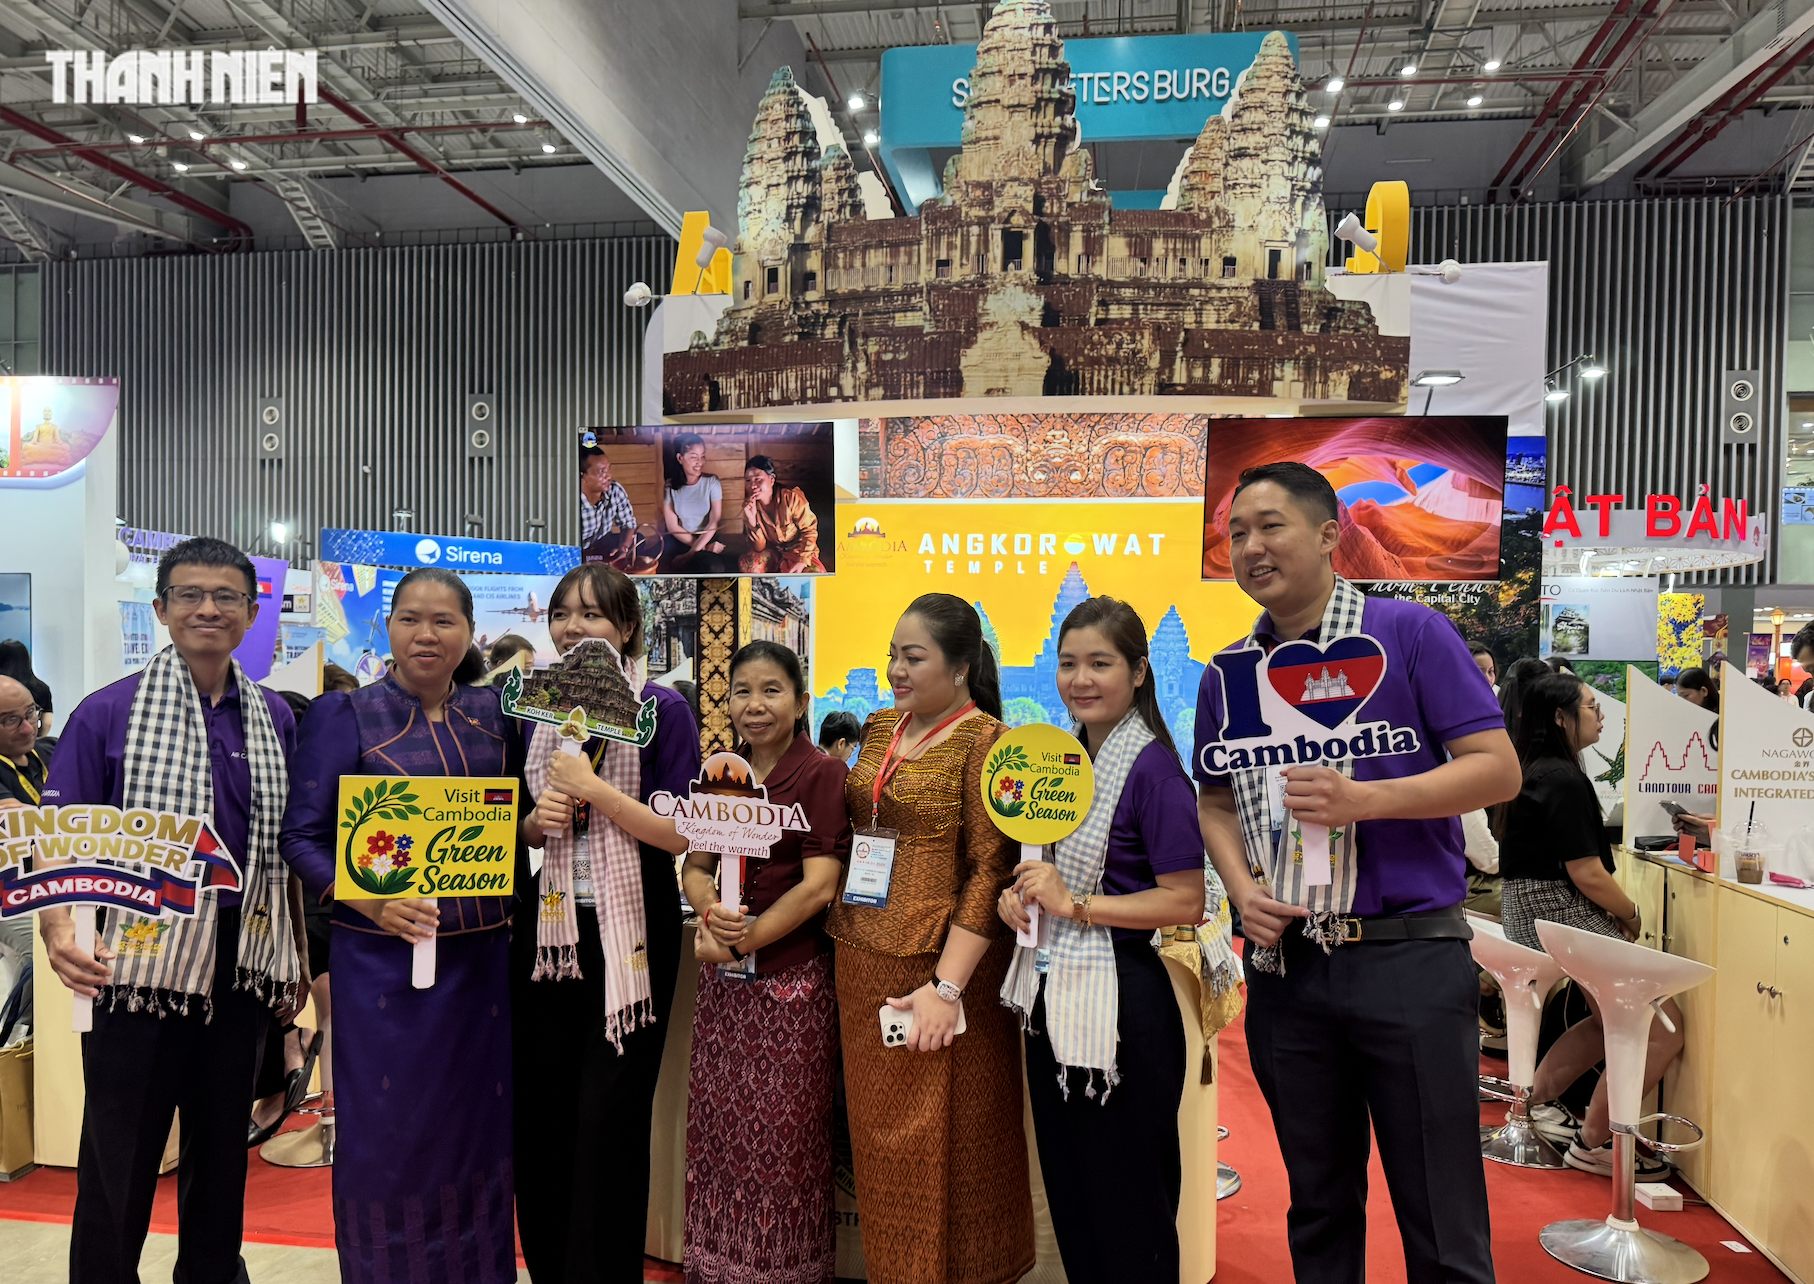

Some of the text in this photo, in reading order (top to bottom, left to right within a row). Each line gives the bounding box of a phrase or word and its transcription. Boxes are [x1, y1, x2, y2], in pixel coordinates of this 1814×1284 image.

[1068, 67, 1231, 103] TERSBURG
[1542, 484, 1748, 548] ẬT BẢN
[120, 527, 190, 551] CAMB
[918, 533, 1166, 556] ANGKOR WAT
[446, 546, 503, 565] Sirena
[924, 560, 1048, 575] TEMPLE
[1395, 593, 1481, 606] the Capital City
[1541, 585, 1562, 596] TO
[1213, 649, 1272, 741] I
[526, 707, 554, 719] KOH KER
[597, 724, 623, 736] TEMPLE
[1041, 751, 1063, 763] Visit
[1203, 724, 1419, 772] Cambodia
[1030, 763, 1080, 776] Cambodia
[444, 788, 481, 803] Visit
[1030, 776, 1077, 803] Green
[1638, 782, 1691, 794] LANDTOUR
[423, 806, 511, 822] Cambodia
[651, 793, 807, 829] CAMBODIA
[1026, 801, 1078, 822] Season
[677, 821, 780, 841] Kingdom of Wonder
[38, 835, 188, 873] WONDER
[425, 825, 508, 865] Green
[690, 839, 768, 857] feel the warmth
[418, 864, 510, 895] Season
[7, 877, 157, 907] CAMBODIA
